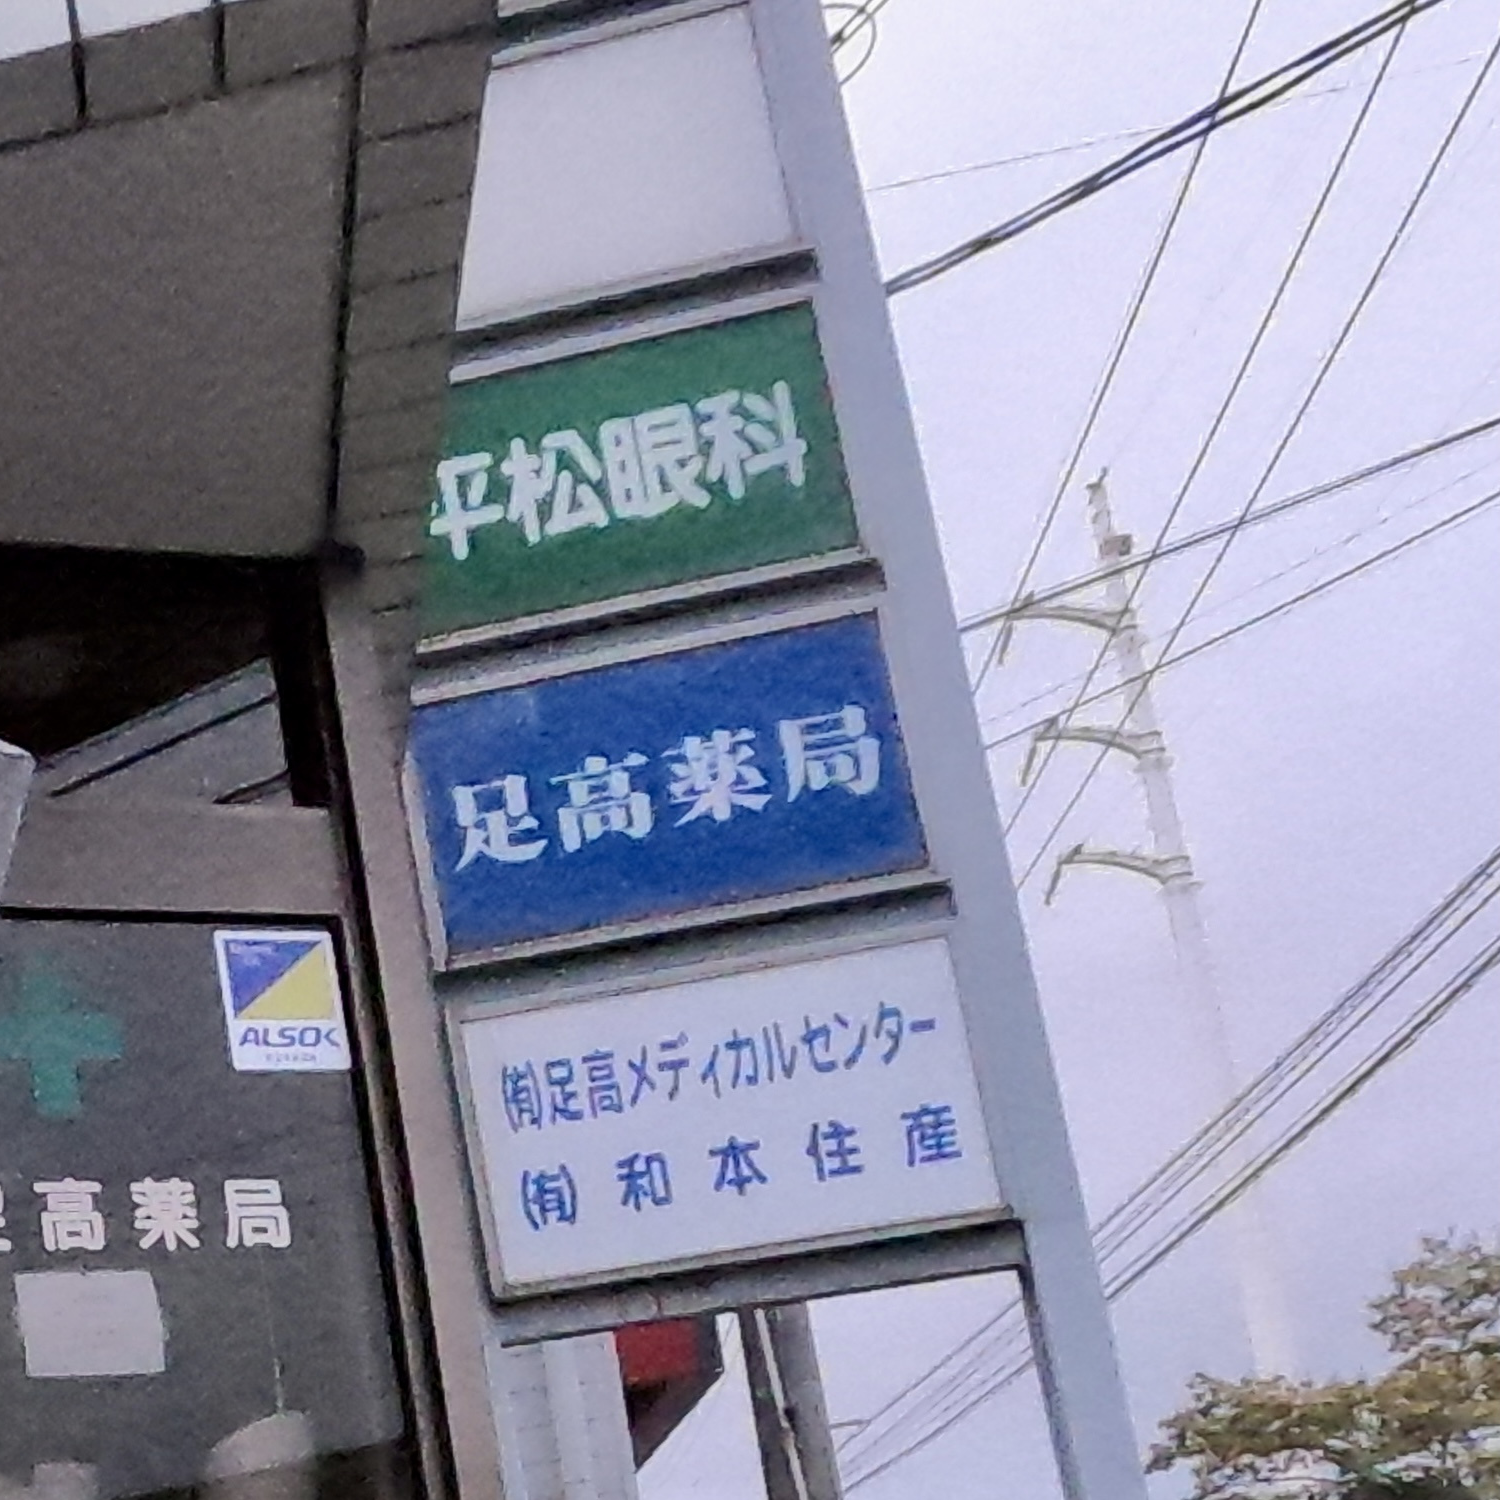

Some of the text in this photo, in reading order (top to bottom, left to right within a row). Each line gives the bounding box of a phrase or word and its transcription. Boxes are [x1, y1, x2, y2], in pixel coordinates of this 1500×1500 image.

[430, 380, 808, 560] 平松眼科
[453, 704, 880, 871] 足高薬局
[239, 1026, 341, 1048] ALSOK
